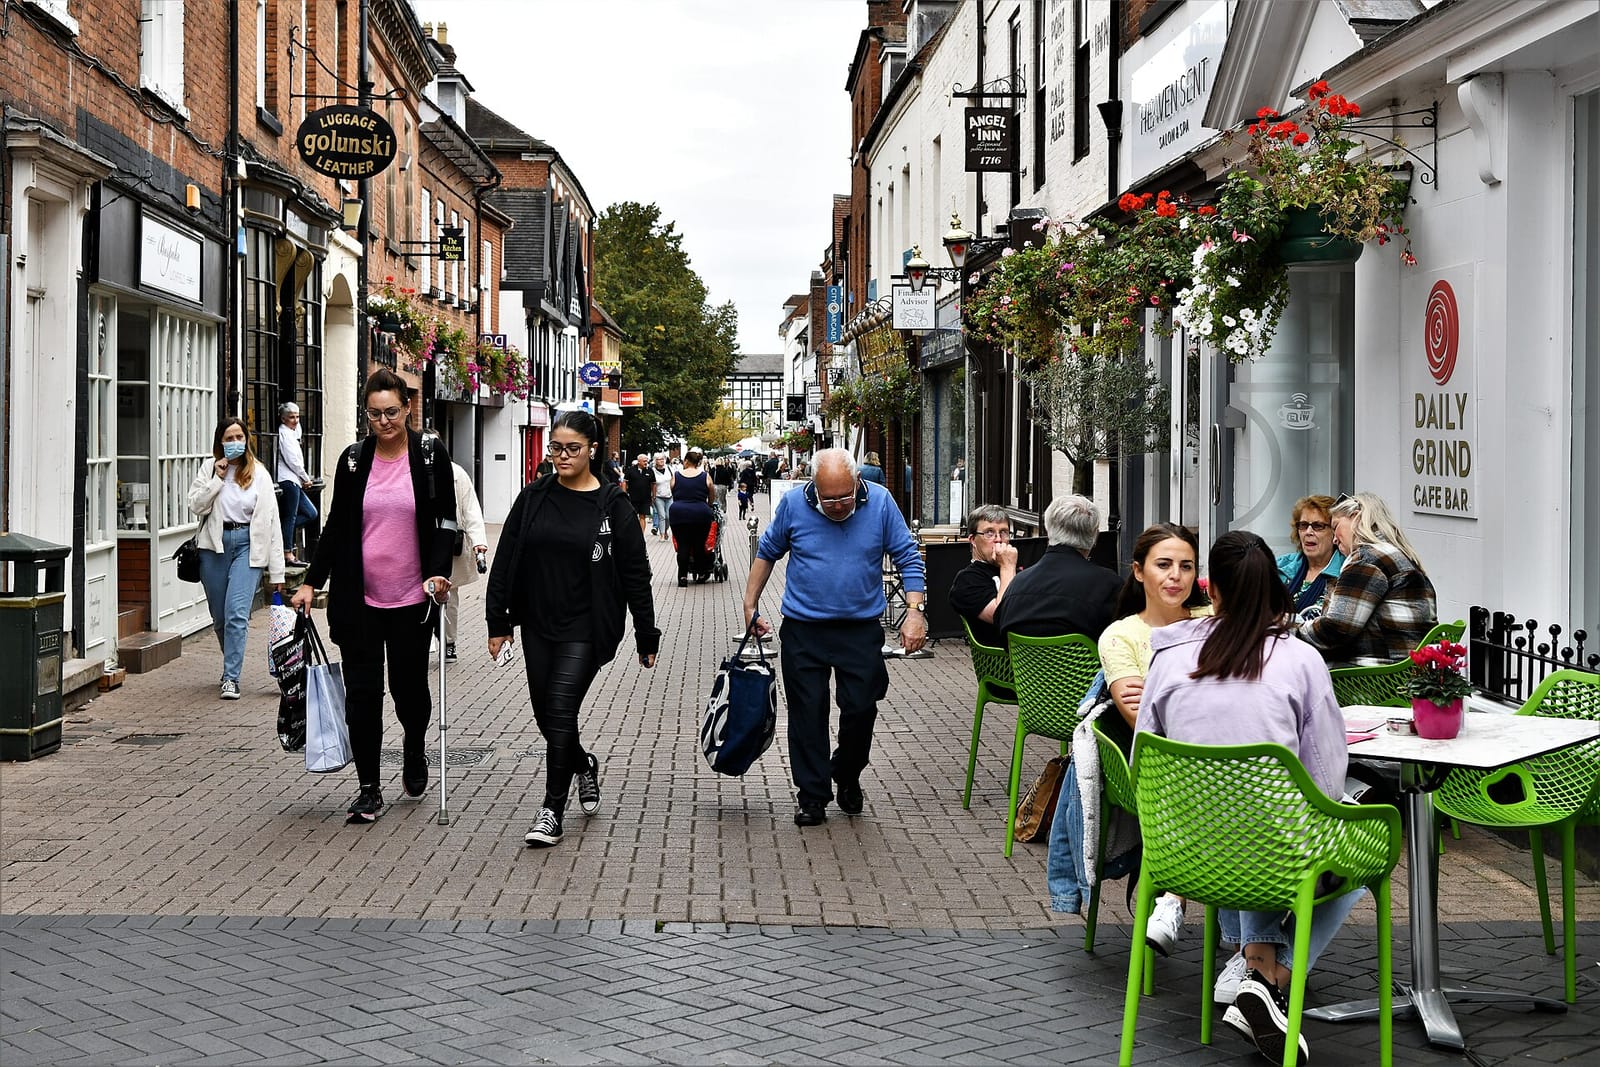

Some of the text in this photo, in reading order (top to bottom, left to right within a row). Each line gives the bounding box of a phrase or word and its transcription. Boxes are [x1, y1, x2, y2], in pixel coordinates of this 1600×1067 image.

[1140, 56, 1209, 136] HEAVEN SENT
[319, 113, 377, 131] LUGGAGE
[969, 114, 1007, 130] ANGEL
[1050, 109, 1066, 145] ALES
[977, 127, 1001, 141] INN
[1158, 127, 1176, 150] SALON
[1179, 119, 1189, 137] SPA
[303, 129, 391, 157] golunski
[315, 155, 374, 175] LEATHER
[980, 156, 1002, 165] 1716
[442, 244, 462, 252] Kitchen
[447, 237, 457, 245] The
[445, 251, 459, 260] Shop
[898, 289, 930, 297] Financial
[900, 297, 928, 305] Advisor
[830, 287, 838, 341] CITY ARCADE
[787, 402, 804, 416] 24
[1414, 392, 1468, 430] DAILY
[1412, 438, 1472, 478] GRIND
[1413, 484, 1469, 512] CAFE BAR
[39, 633, 59, 650] LITTER
